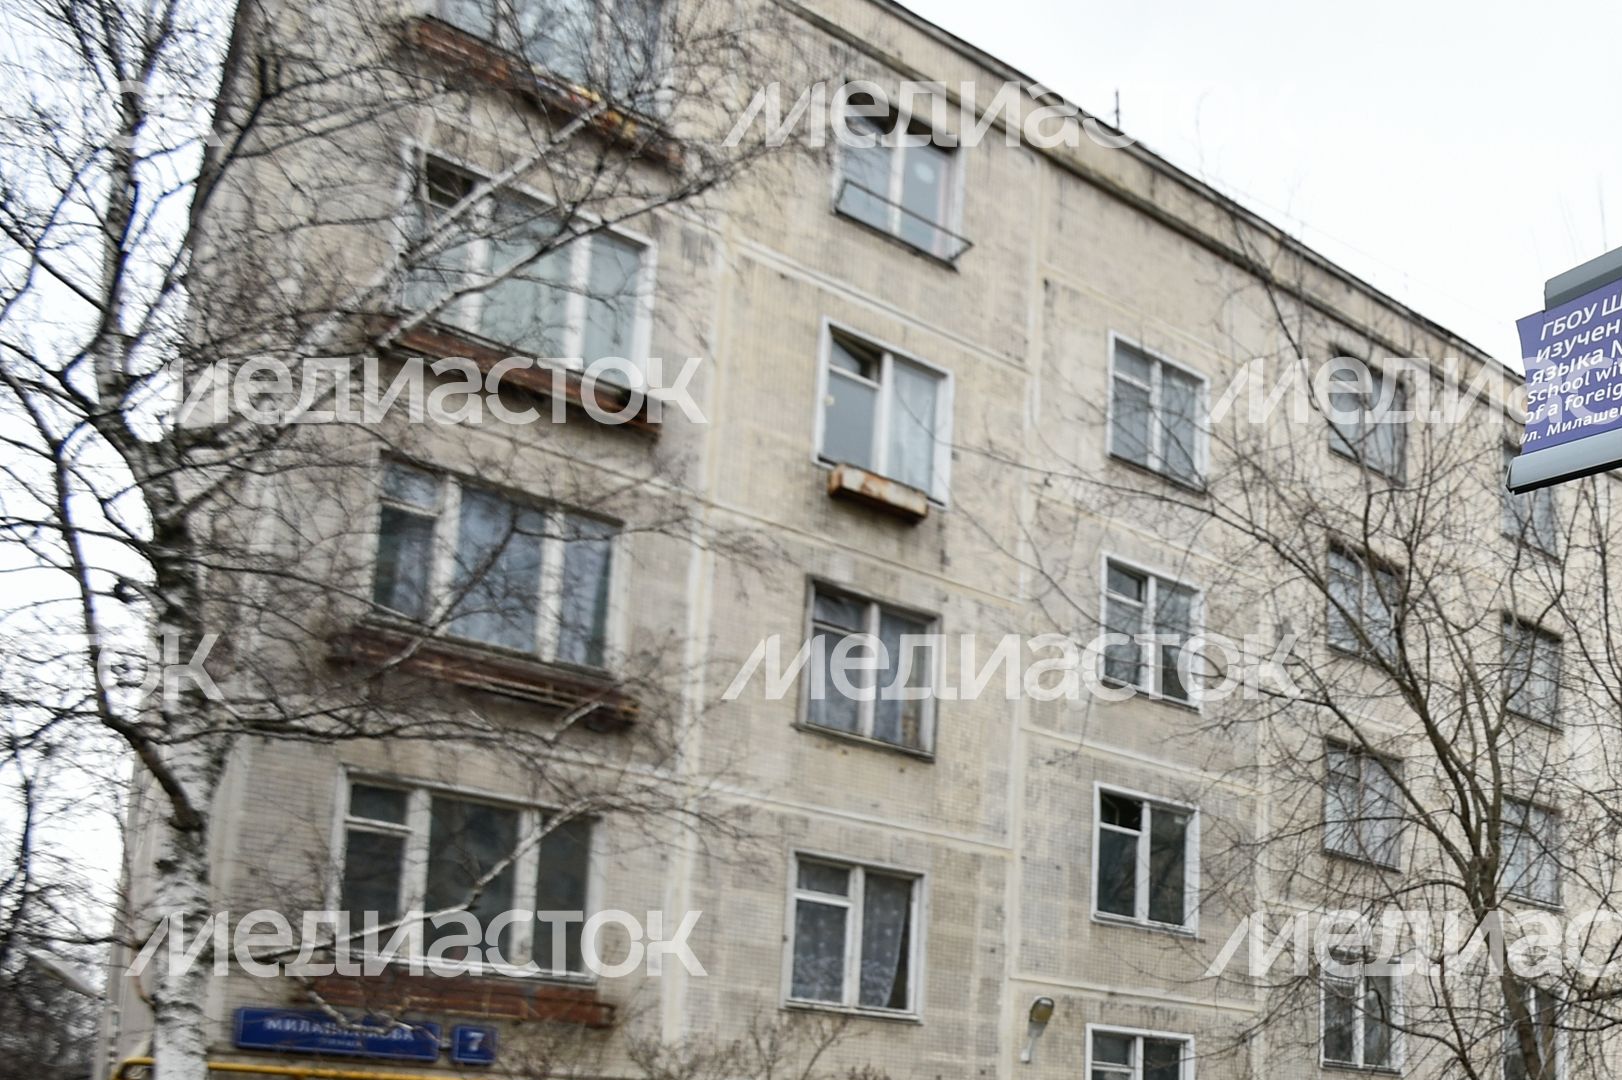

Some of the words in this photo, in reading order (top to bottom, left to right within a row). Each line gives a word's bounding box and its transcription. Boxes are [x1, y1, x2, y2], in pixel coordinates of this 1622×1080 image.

[1540, 302, 1598, 341] ГБОУ
[1530, 347, 1604, 387] языка
[1525, 404, 1546, 424] of
[1547, 403, 1559, 417] a
[467, 1031, 486, 1052] 7
